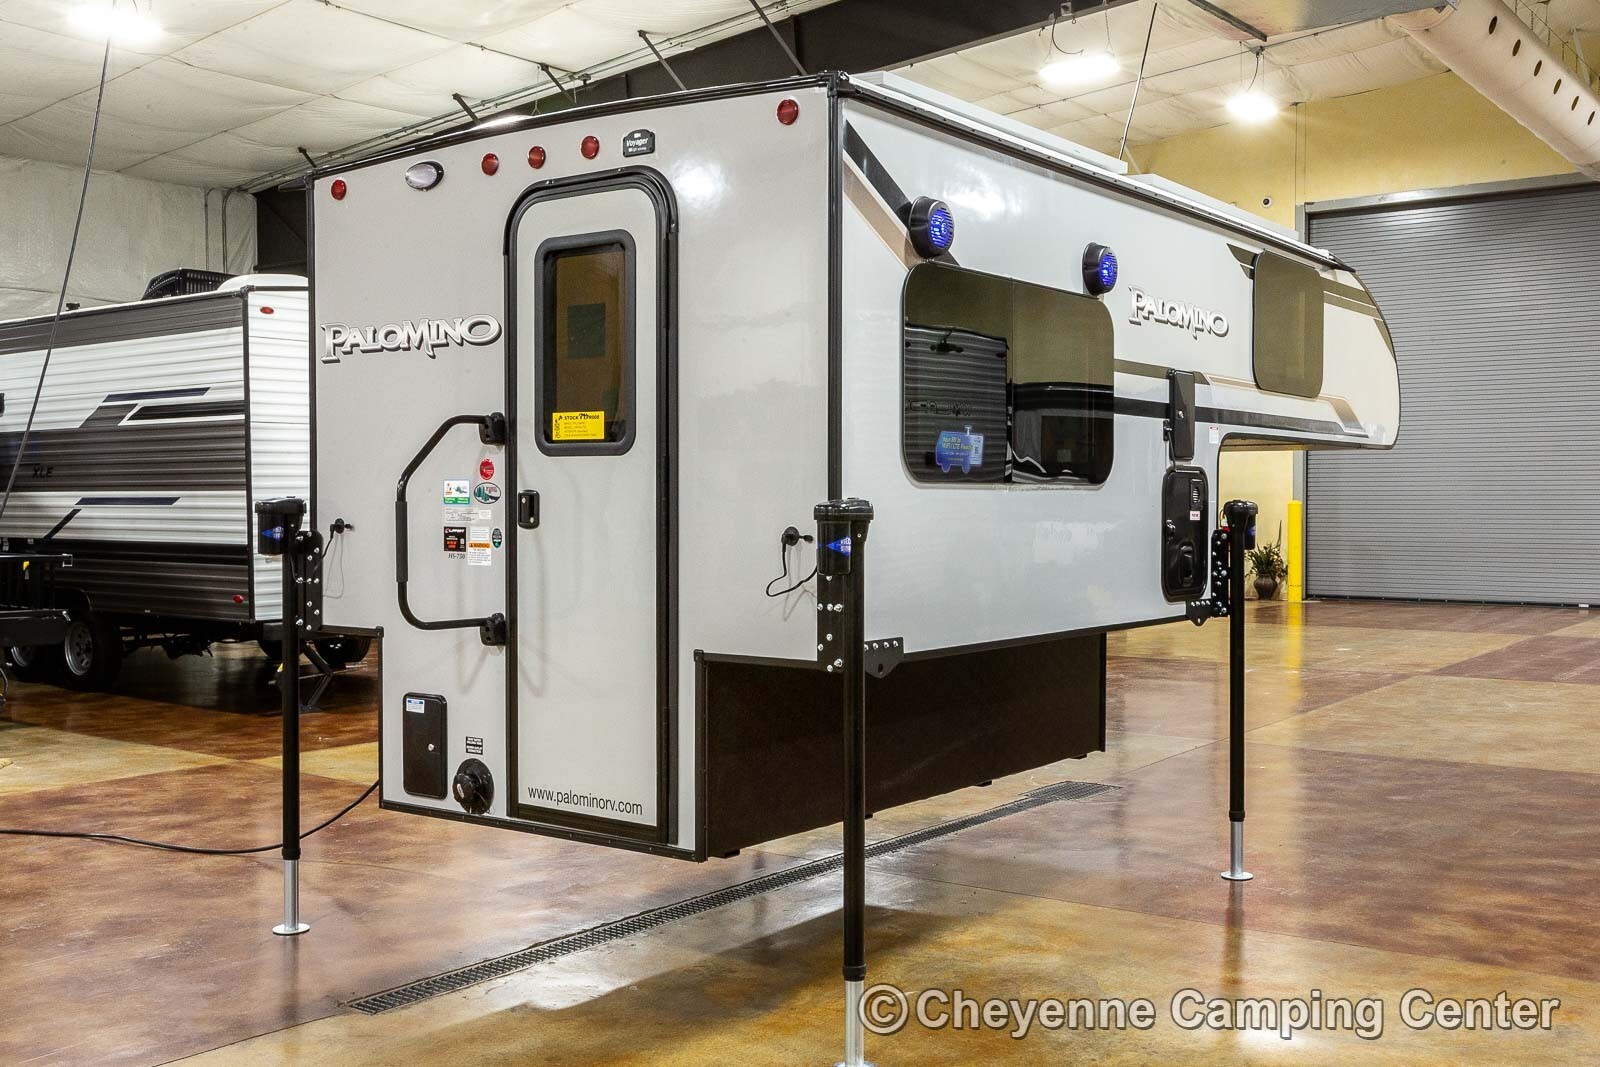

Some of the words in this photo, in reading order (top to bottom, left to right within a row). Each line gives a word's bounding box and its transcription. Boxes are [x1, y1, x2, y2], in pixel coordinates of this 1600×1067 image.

[626, 138, 648, 147] Voyager
[1128, 284, 1230, 341] PALOMINO
[320, 314, 502, 364] PALOMINO
[528, 786, 643, 815] www.palominorv.com
